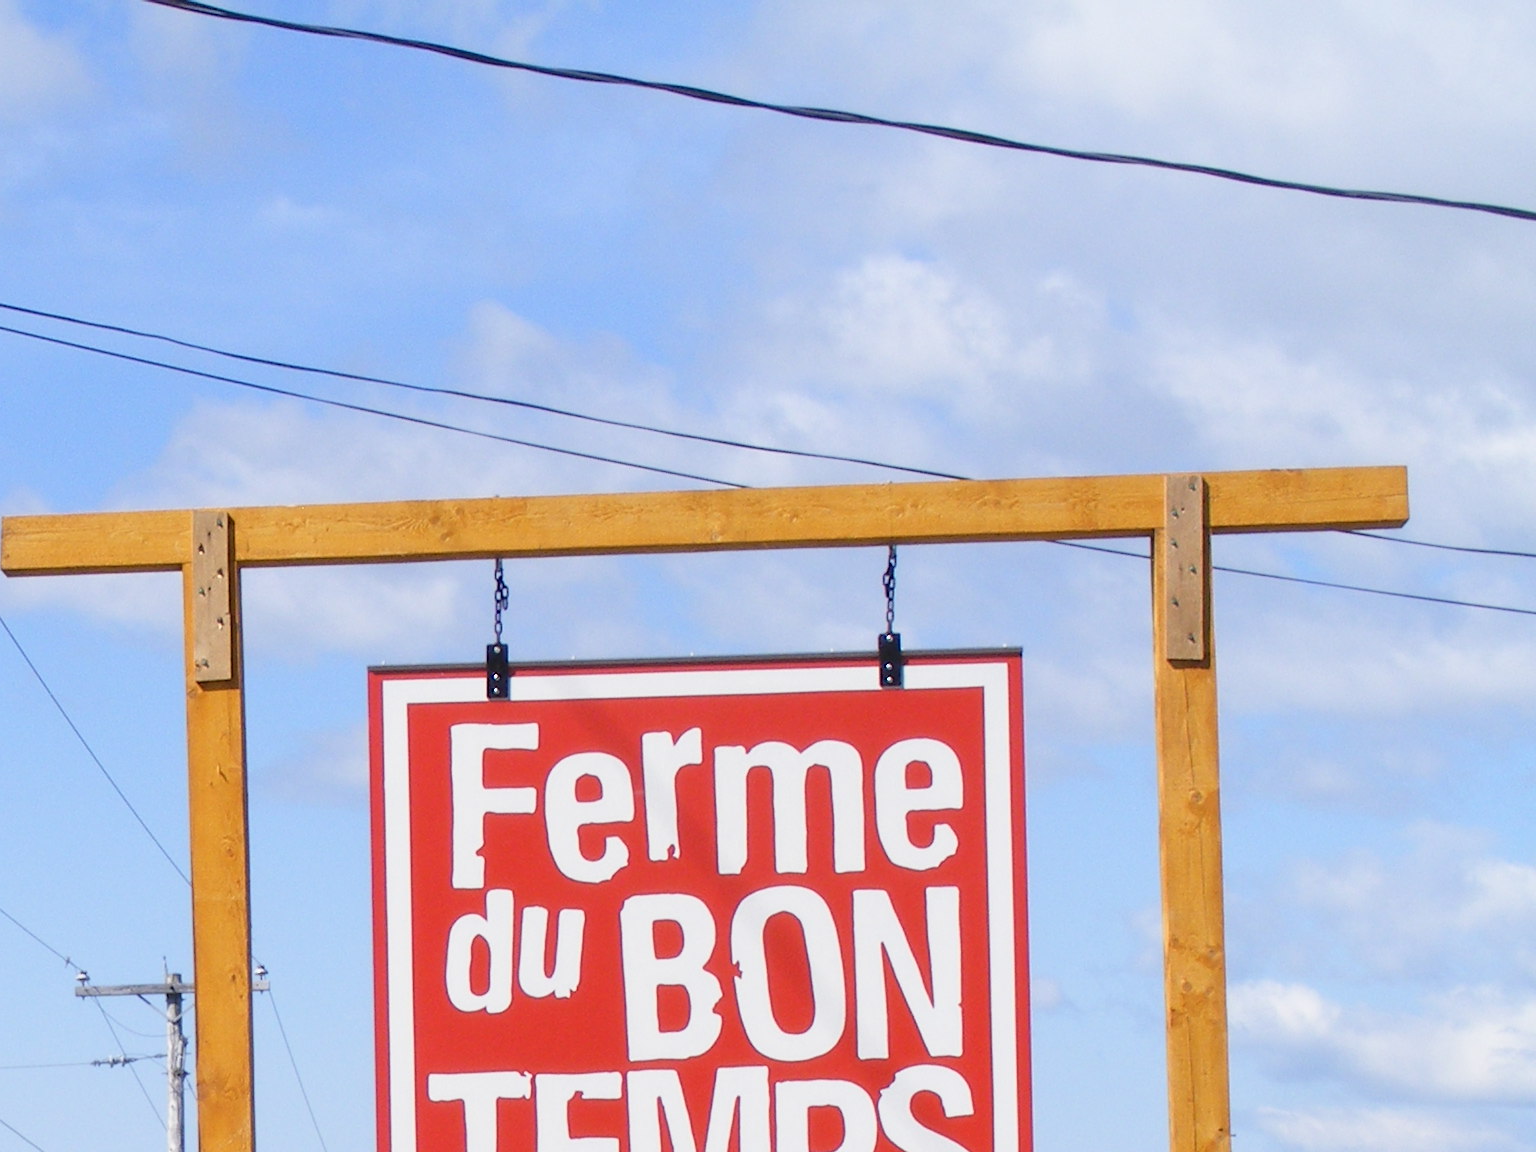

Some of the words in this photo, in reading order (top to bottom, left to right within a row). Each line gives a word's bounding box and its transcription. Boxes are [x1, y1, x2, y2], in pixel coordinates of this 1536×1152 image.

[450, 723, 964, 889] Ferme
[445, 889, 586, 1015] du
[620, 885, 964, 1063] BON
